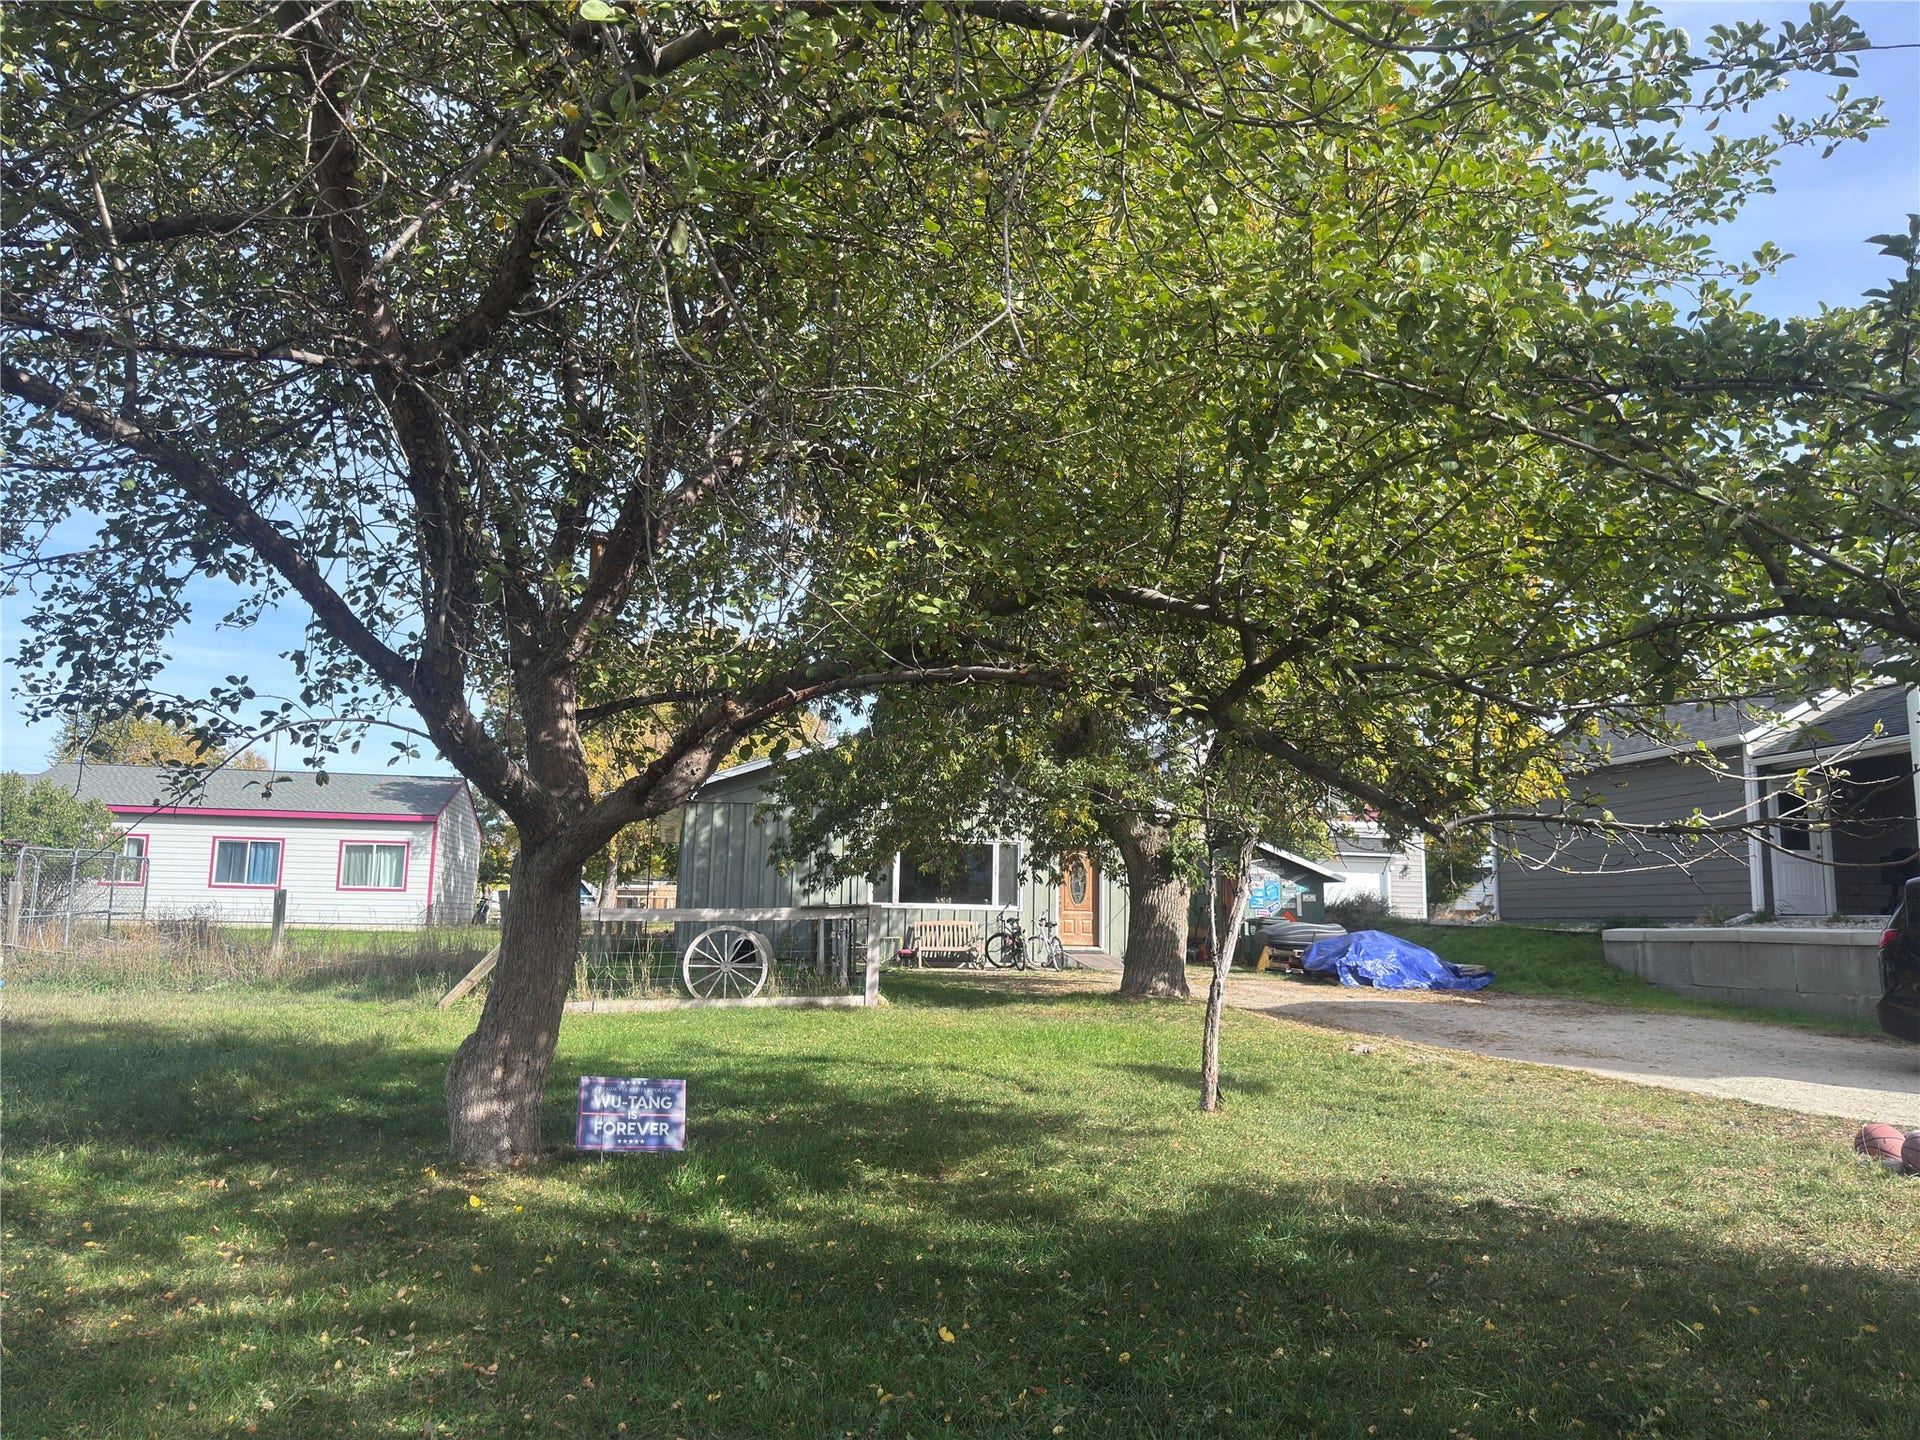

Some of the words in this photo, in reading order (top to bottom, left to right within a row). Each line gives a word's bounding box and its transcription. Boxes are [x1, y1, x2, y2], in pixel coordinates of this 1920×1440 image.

[593, 1094, 673, 1109] WU-TANG
[628, 1110, 638, 1120] IS
[594, 1121, 669, 1136] FOREVER
